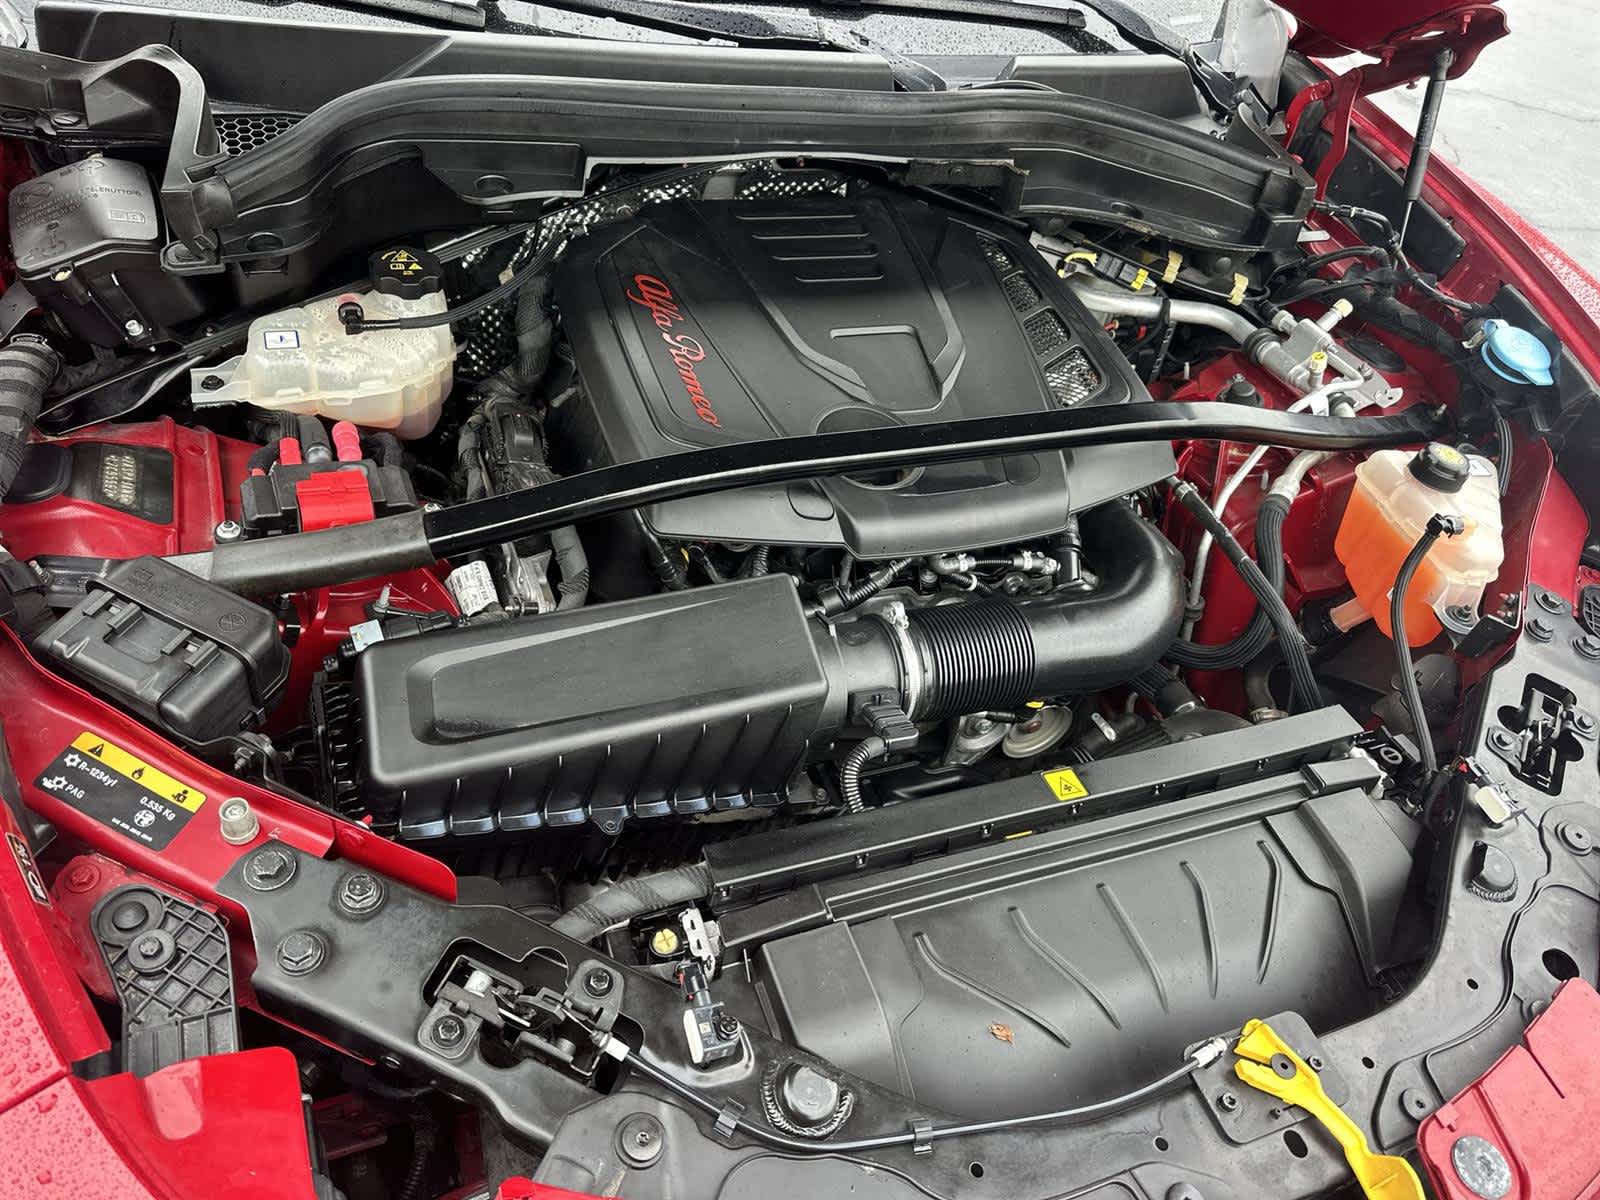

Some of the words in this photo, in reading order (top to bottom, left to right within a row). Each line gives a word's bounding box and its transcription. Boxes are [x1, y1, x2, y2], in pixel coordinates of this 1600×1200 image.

[626, 273, 684, 333] Alfa
[661, 333, 722, 429] Romeo
[64, 783, 86, 799] PAG
